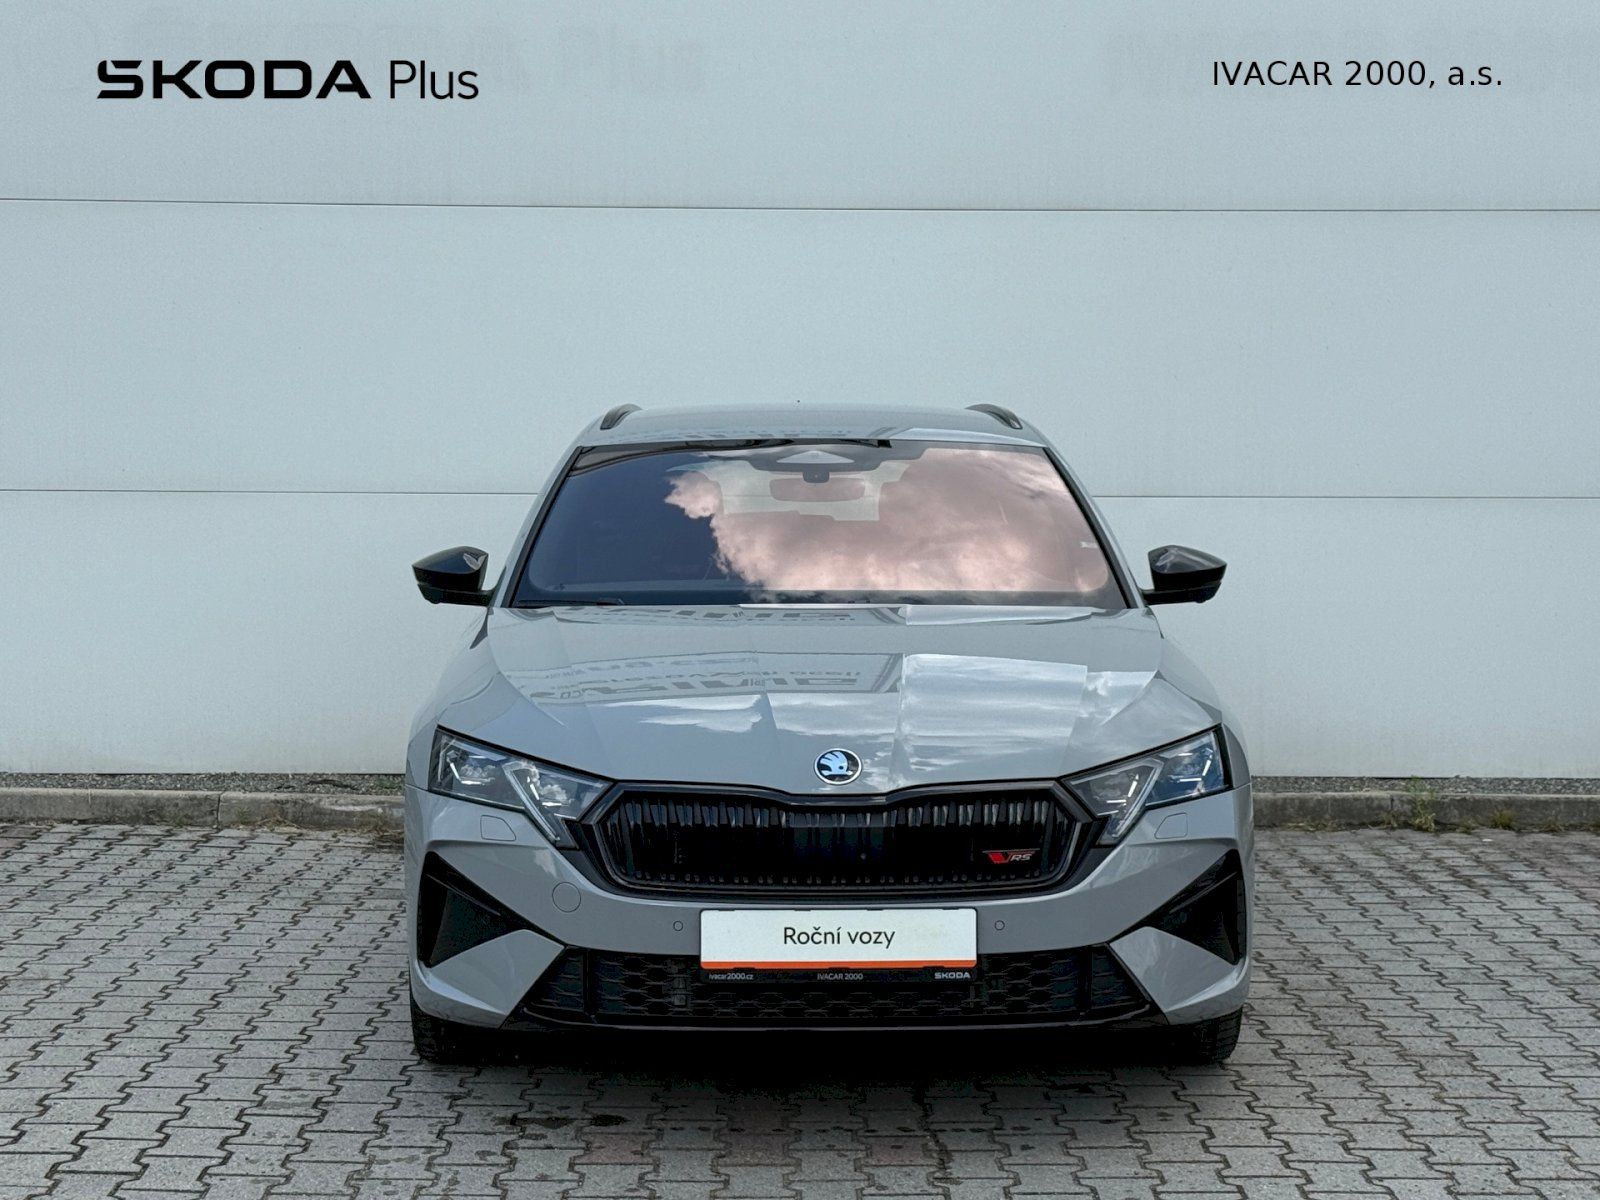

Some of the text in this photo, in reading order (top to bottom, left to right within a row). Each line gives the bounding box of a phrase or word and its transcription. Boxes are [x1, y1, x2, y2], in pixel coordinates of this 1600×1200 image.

[783, 926, 896, 949] Roční vozy
[708, 972, 754, 980] ivacar2000.cz
